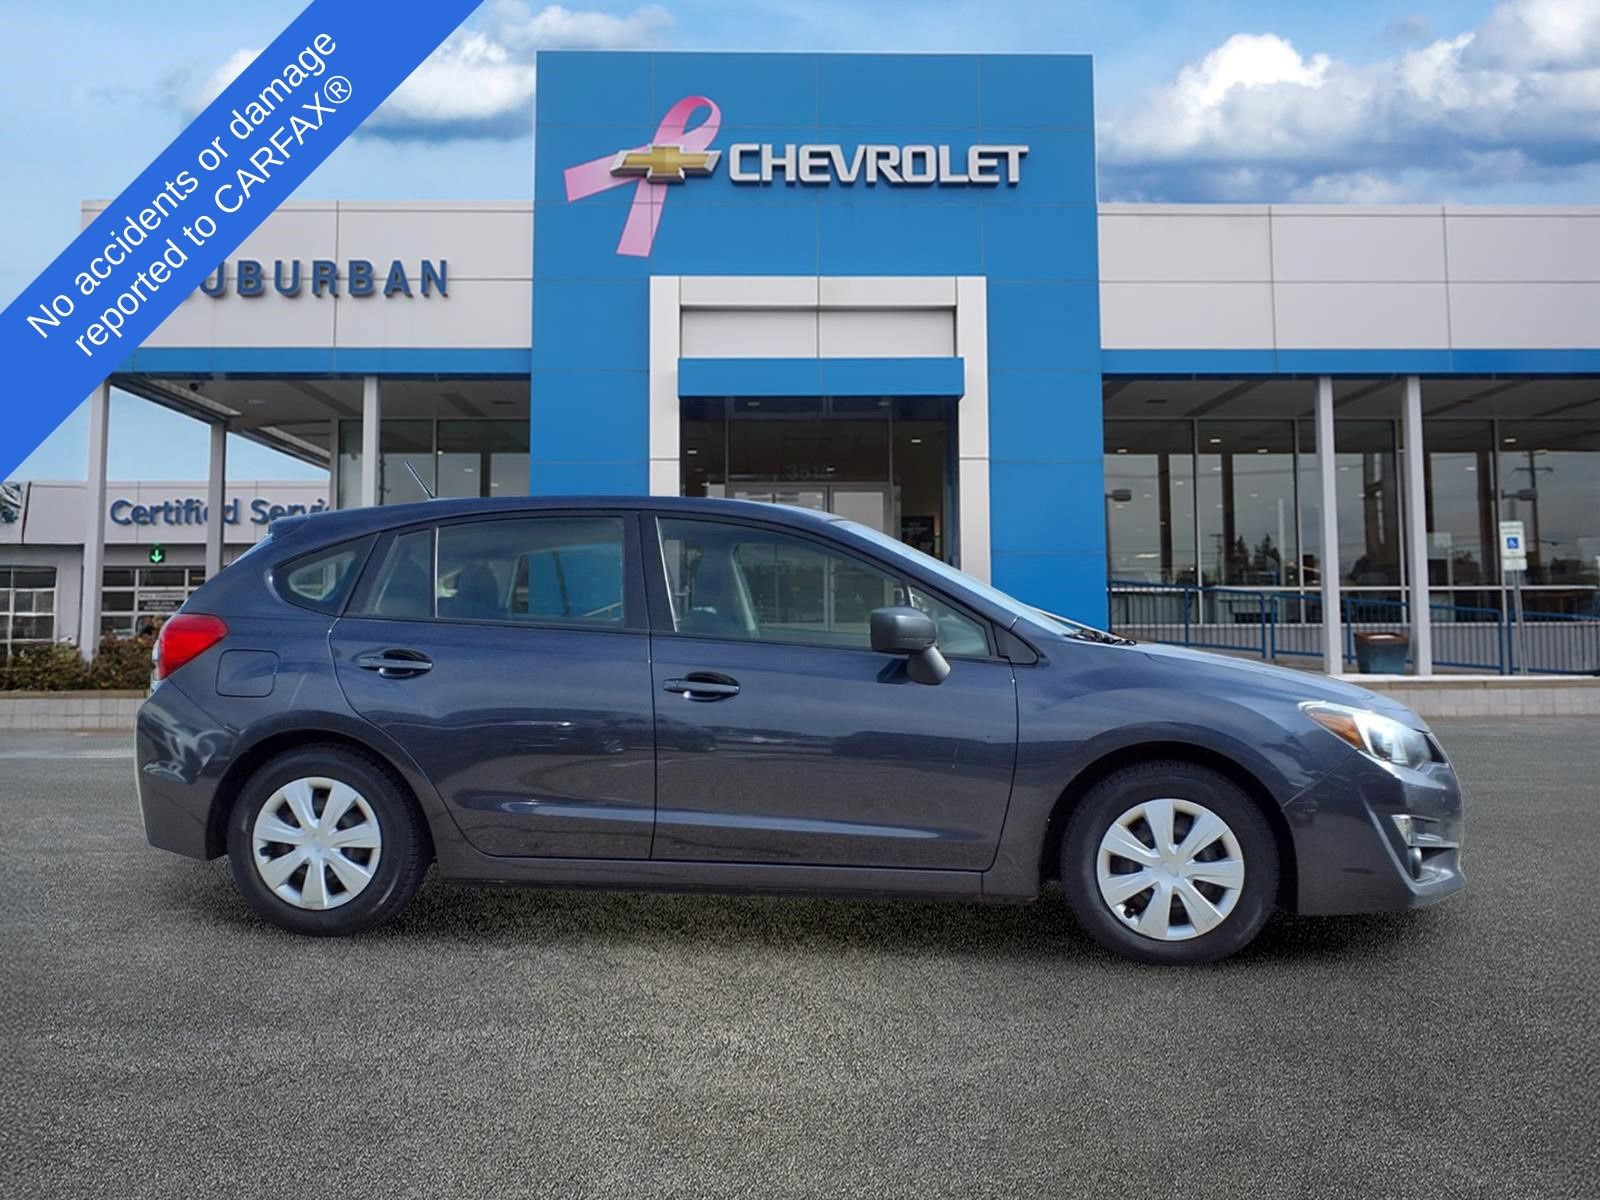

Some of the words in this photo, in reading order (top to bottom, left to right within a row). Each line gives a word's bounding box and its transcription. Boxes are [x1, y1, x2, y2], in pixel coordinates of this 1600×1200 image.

[729, 144, 1029, 185] CHEVROLET
[199, 260, 448, 297] UBURBAN
[110, 498, 240, 525] Certifid
